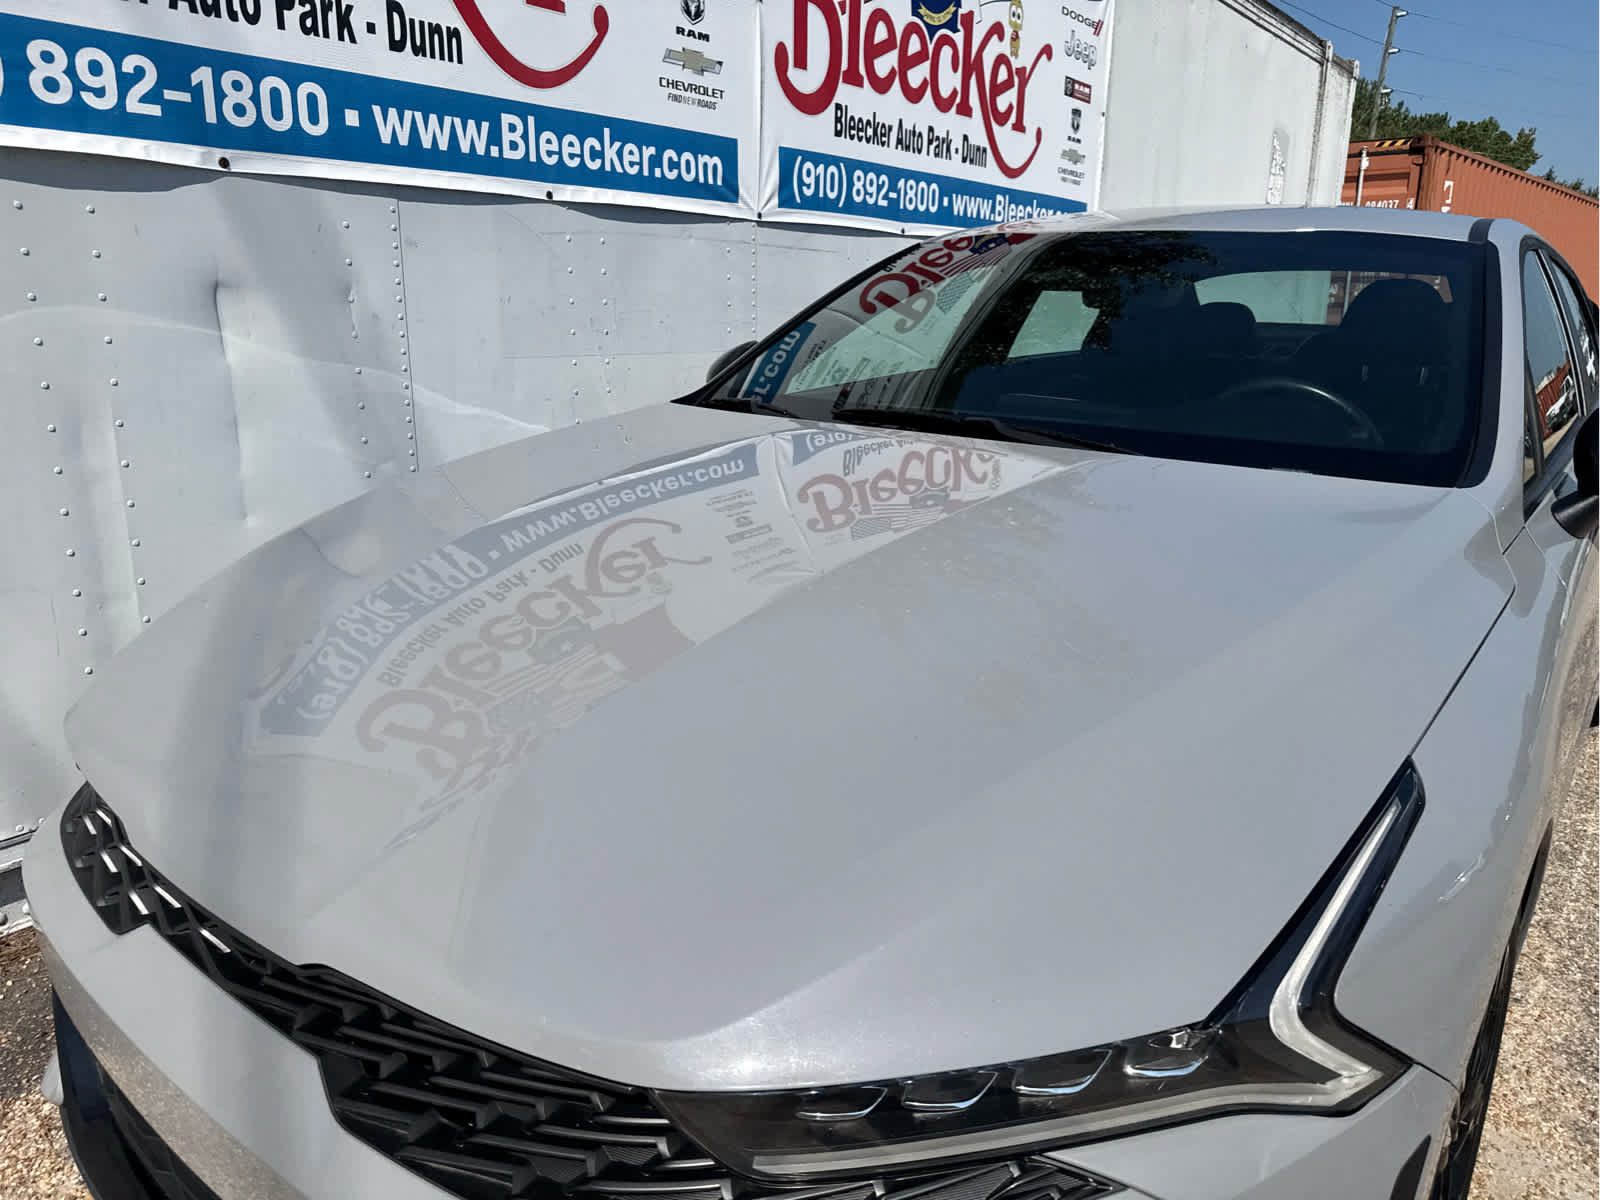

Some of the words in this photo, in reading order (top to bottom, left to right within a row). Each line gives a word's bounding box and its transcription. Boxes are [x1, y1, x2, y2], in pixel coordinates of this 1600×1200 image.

[385, 0, 463, 65] Dunn
[675, 26, 710, 42] RAM
[1062, 6, 1098, 31] DODGE
[1064, 30, 1097, 70] Jeep
[26, 39, 329, 136] 892-1800
[371, 104, 723, 186] www.Bleecker.com
[659, 77, 725, 100] CHEVROLET
[774, 0, 1053, 179] Bleecker
[834, 102, 892, 149] Bleecker
[895, 118, 923, 153] Auto
[926, 131, 952, 165] Park
[962, 134, 988, 168] Dunn
[793, 155, 847, 207] (910)
[852, 170, 940, 213] 892-1800
